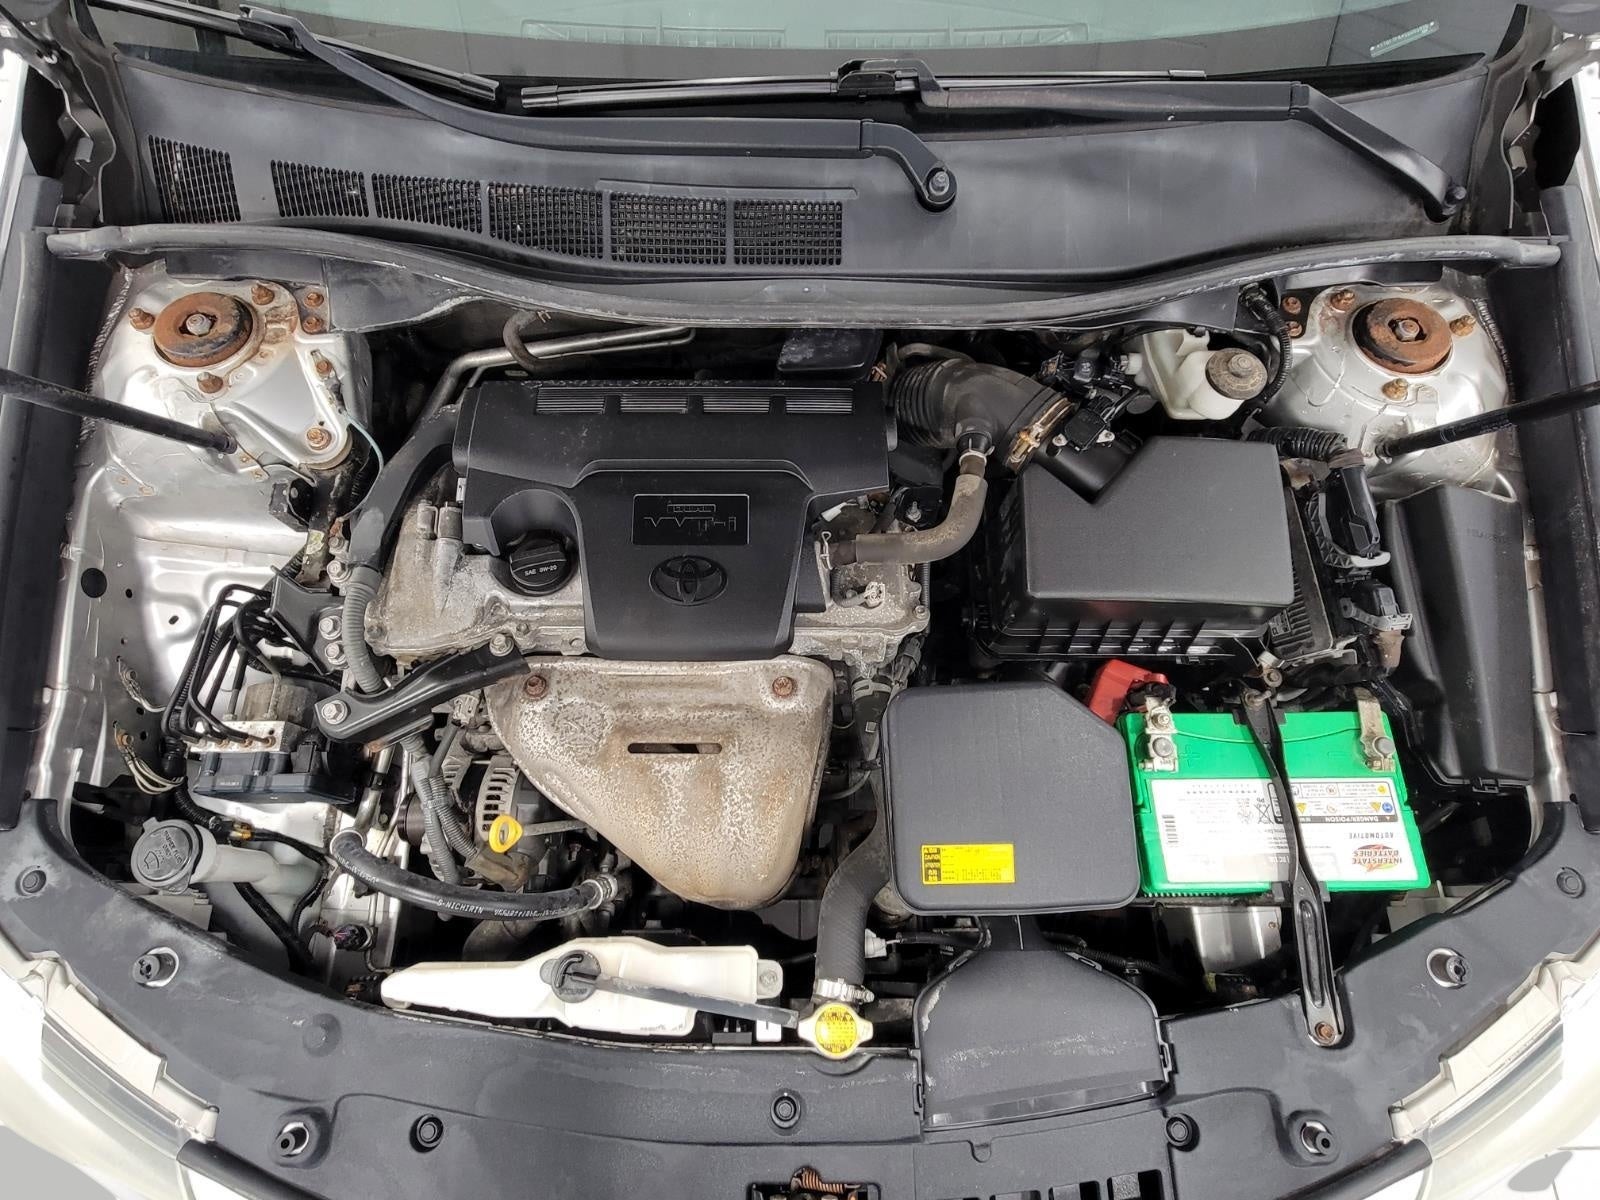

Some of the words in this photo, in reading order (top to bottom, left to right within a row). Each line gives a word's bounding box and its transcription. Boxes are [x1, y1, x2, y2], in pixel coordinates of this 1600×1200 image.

[643, 516, 737, 532] VVT-i
[524, 568, 537, 577] SAE
[539, 564, 558, 573] 0W-20
[1348, 831, 1395, 840] AUTOMOTIVE
[1353, 849, 1400, 857] BATTERIES
[1351, 857, 1403, 865] INTERSTATE
[436, 898, 485, 915] S-NICHIRIN
